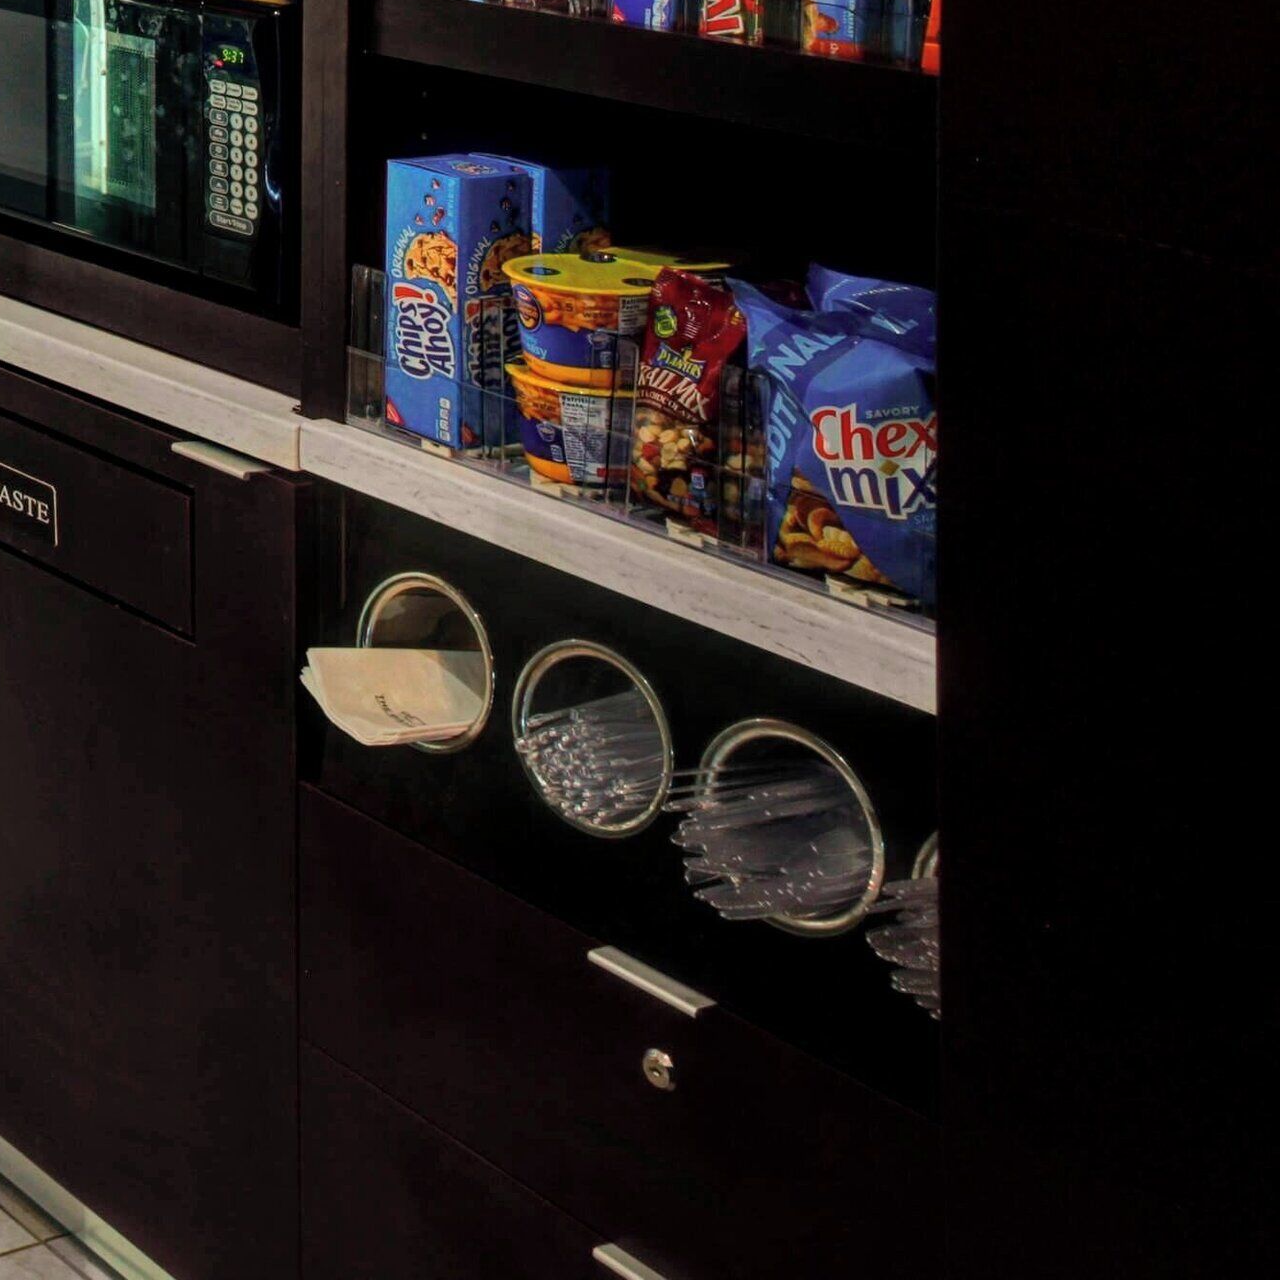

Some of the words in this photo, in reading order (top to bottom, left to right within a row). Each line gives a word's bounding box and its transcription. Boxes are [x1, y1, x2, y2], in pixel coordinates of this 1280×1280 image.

[222, 48, 244, 64] 9:37
[392, 225, 417, 279] ORIGINAL
[465, 235, 491, 295] ORIGINAL
[395, 300, 432, 379] Chips
[639, 365, 670, 393] RAIL
[811, 408, 938, 461] Chex
[865, 405, 920, 420] SAVORY
[830, 458, 938, 516] mix
